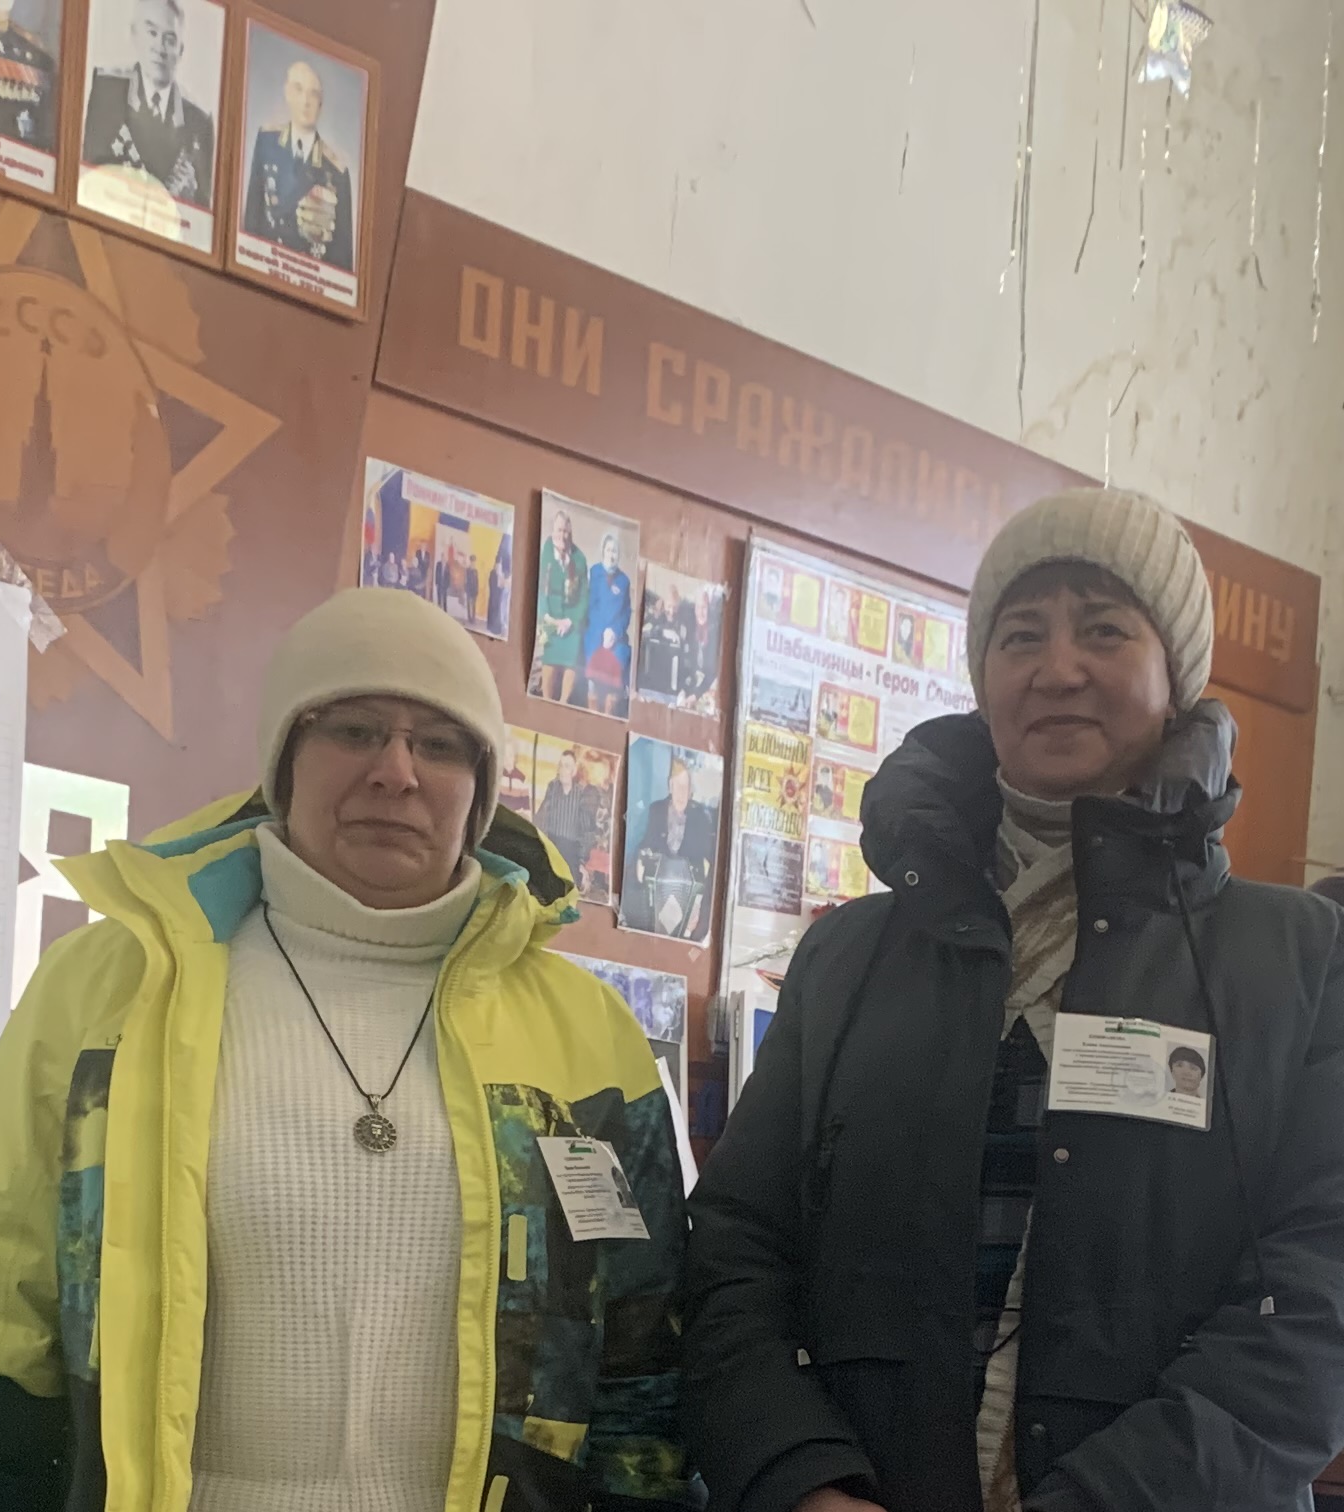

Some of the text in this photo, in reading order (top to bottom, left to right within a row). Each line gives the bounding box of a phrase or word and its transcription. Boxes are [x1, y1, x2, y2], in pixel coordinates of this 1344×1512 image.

[458, 265, 605, 397] ОНИ
[767, 629, 864, 680] Шабалинцы
[875, 663, 919, 698] Герои
[926, 679, 975, 713] Советс
